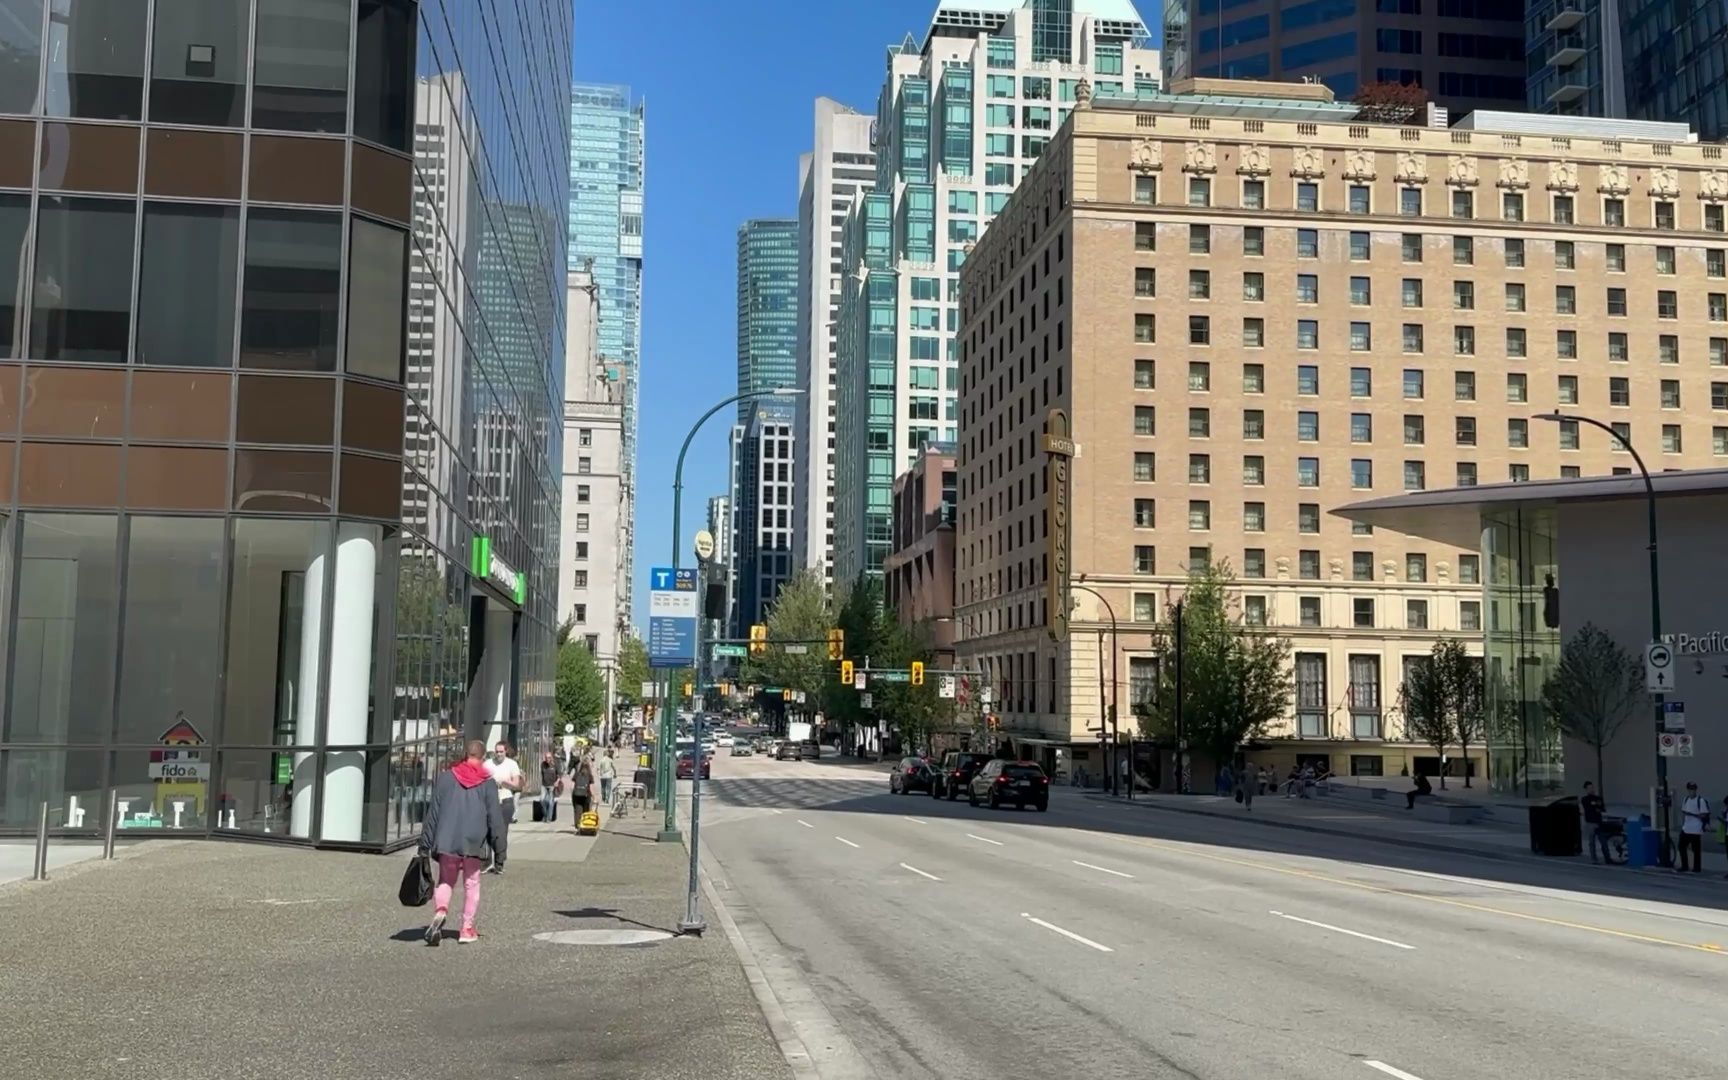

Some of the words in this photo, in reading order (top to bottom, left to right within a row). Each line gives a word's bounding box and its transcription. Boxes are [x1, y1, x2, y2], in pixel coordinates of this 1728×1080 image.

[1055, 461, 1066, 618] GEORGIA
[657, 572, 669, 587] T
[1678, 631, 1728, 653] Pacific
[161, 764, 186, 776] fido
